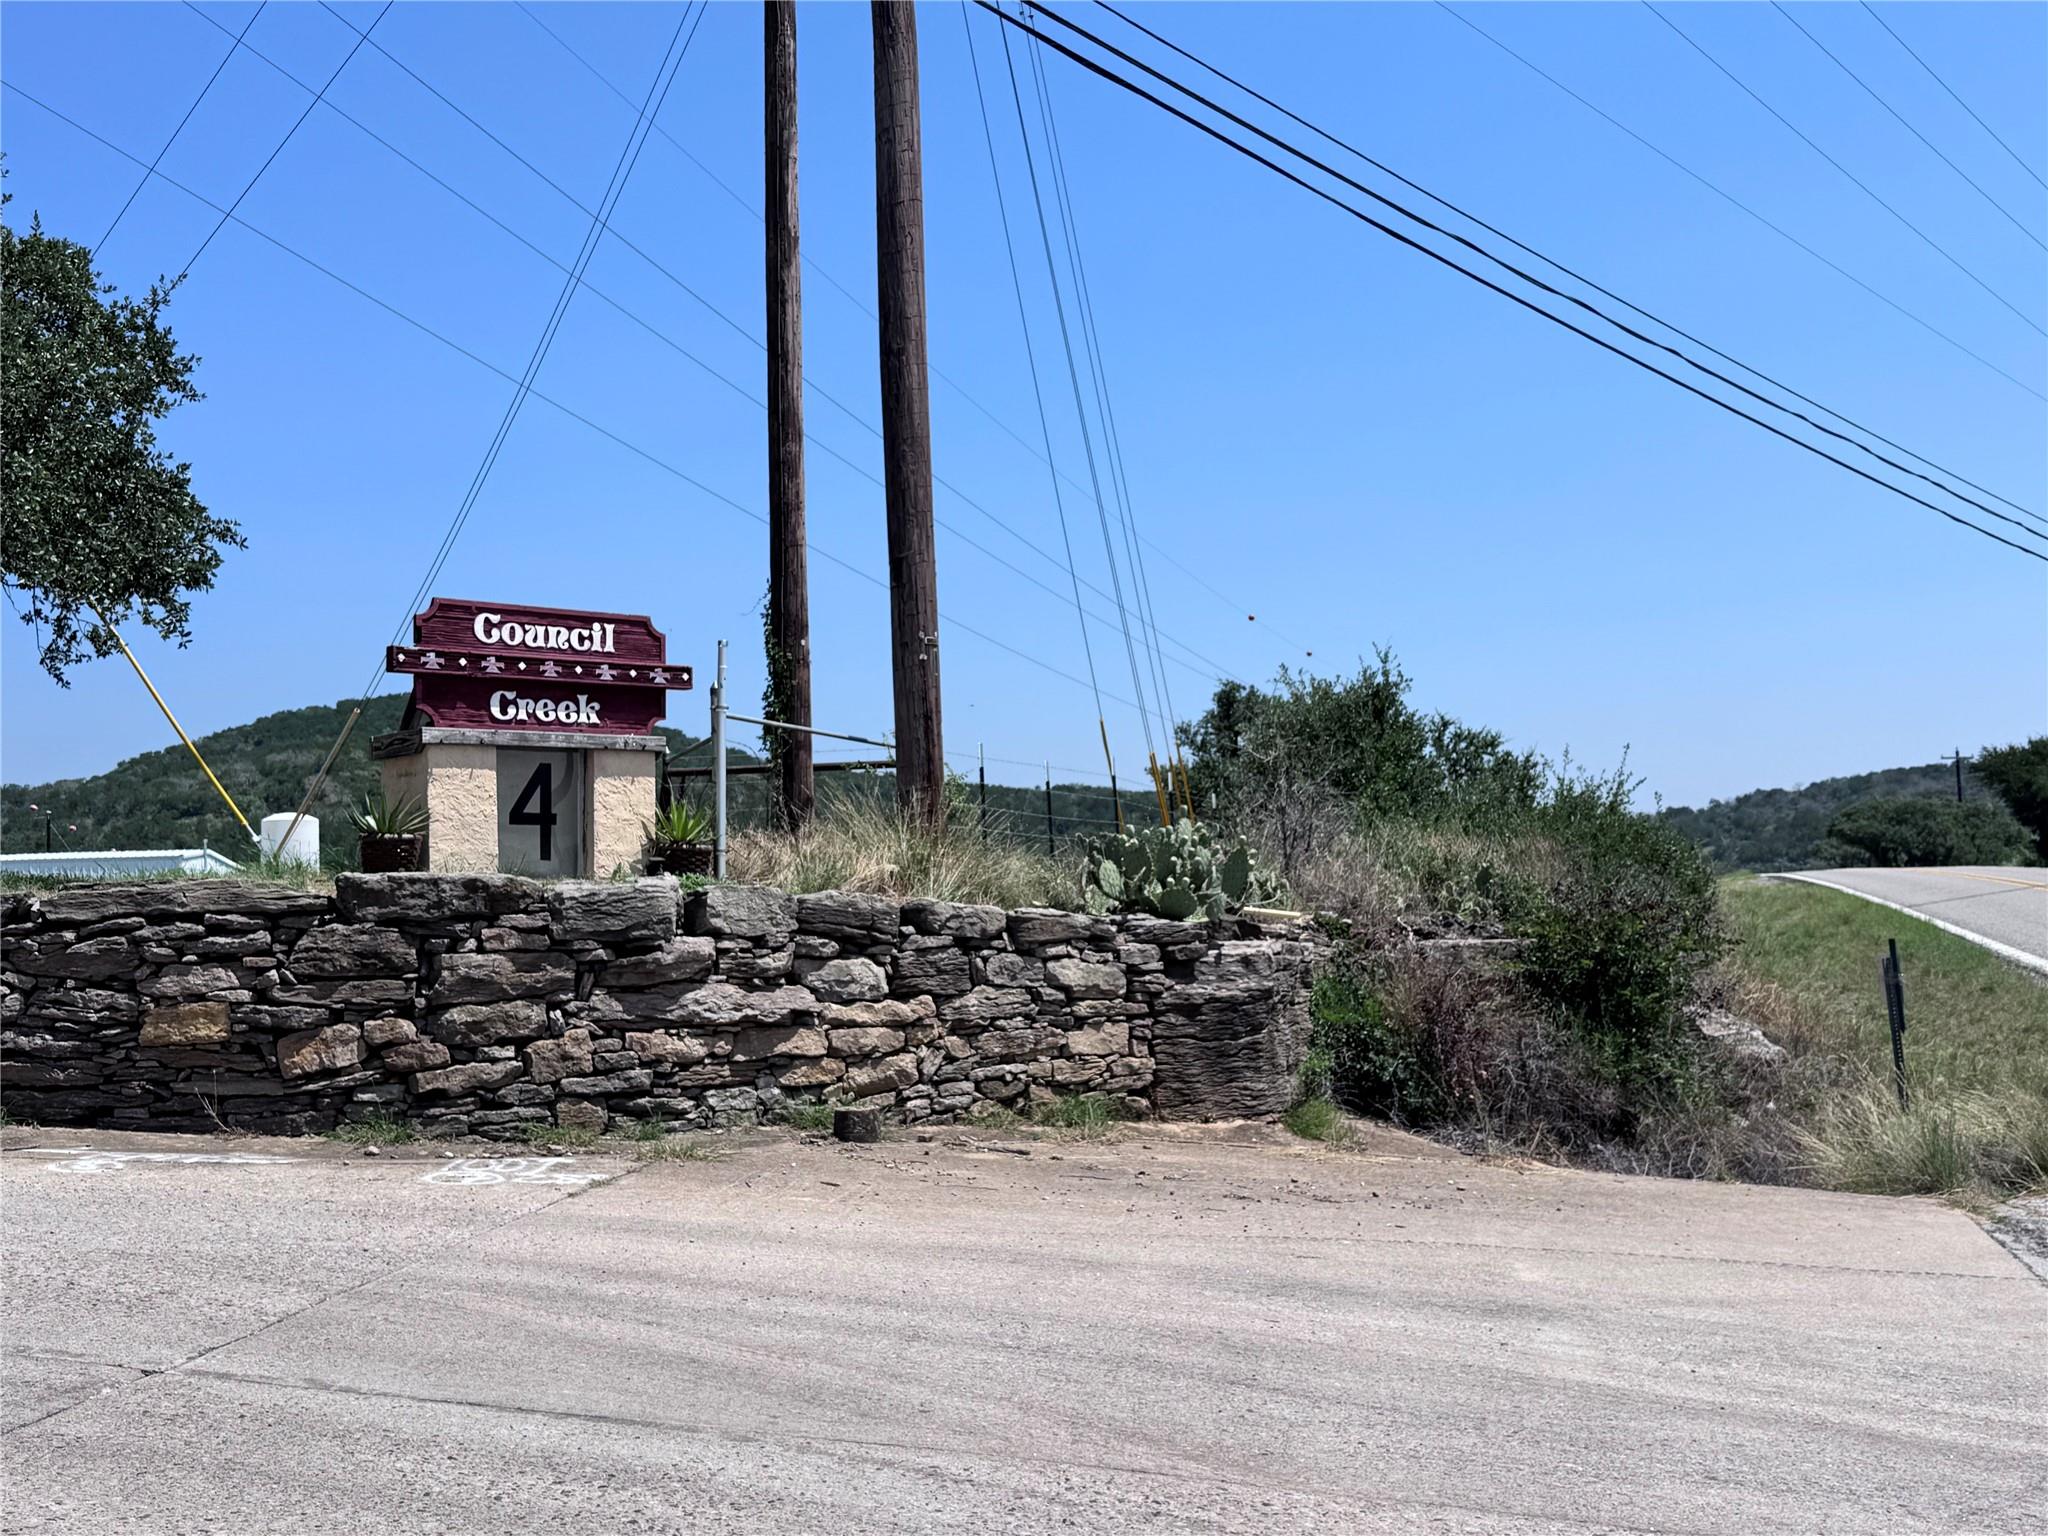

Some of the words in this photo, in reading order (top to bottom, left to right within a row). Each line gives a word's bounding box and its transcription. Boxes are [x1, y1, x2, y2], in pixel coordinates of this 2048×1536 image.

[474, 612, 615, 653] Council
[489, 690, 601, 724] Creek
[508, 762, 557, 861] 4
